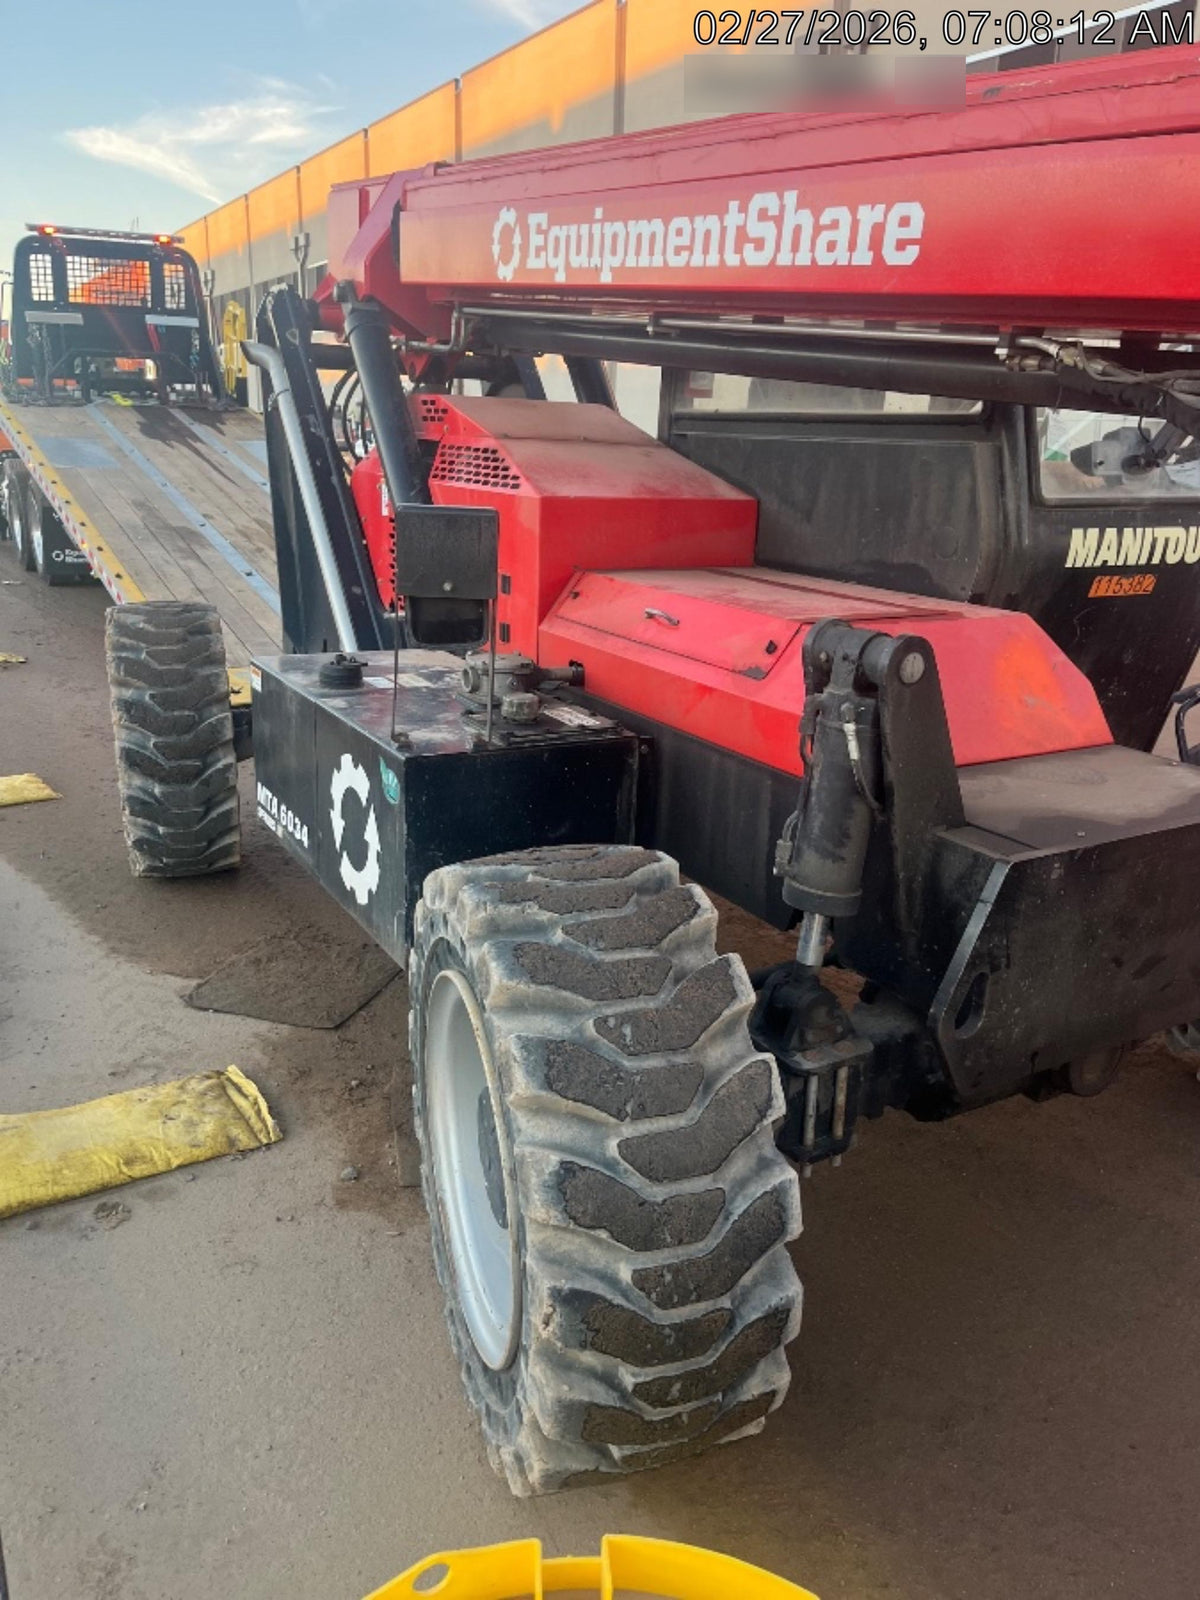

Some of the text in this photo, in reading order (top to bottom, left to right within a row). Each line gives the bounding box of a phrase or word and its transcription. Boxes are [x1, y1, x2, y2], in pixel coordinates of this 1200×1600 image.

[526, 190, 925, 283] EquipmentShare
[1065, 526, 1200, 568] MANITOU
[1091, 573, 1155, 595] 115382
[257, 781, 279, 820] MTA
